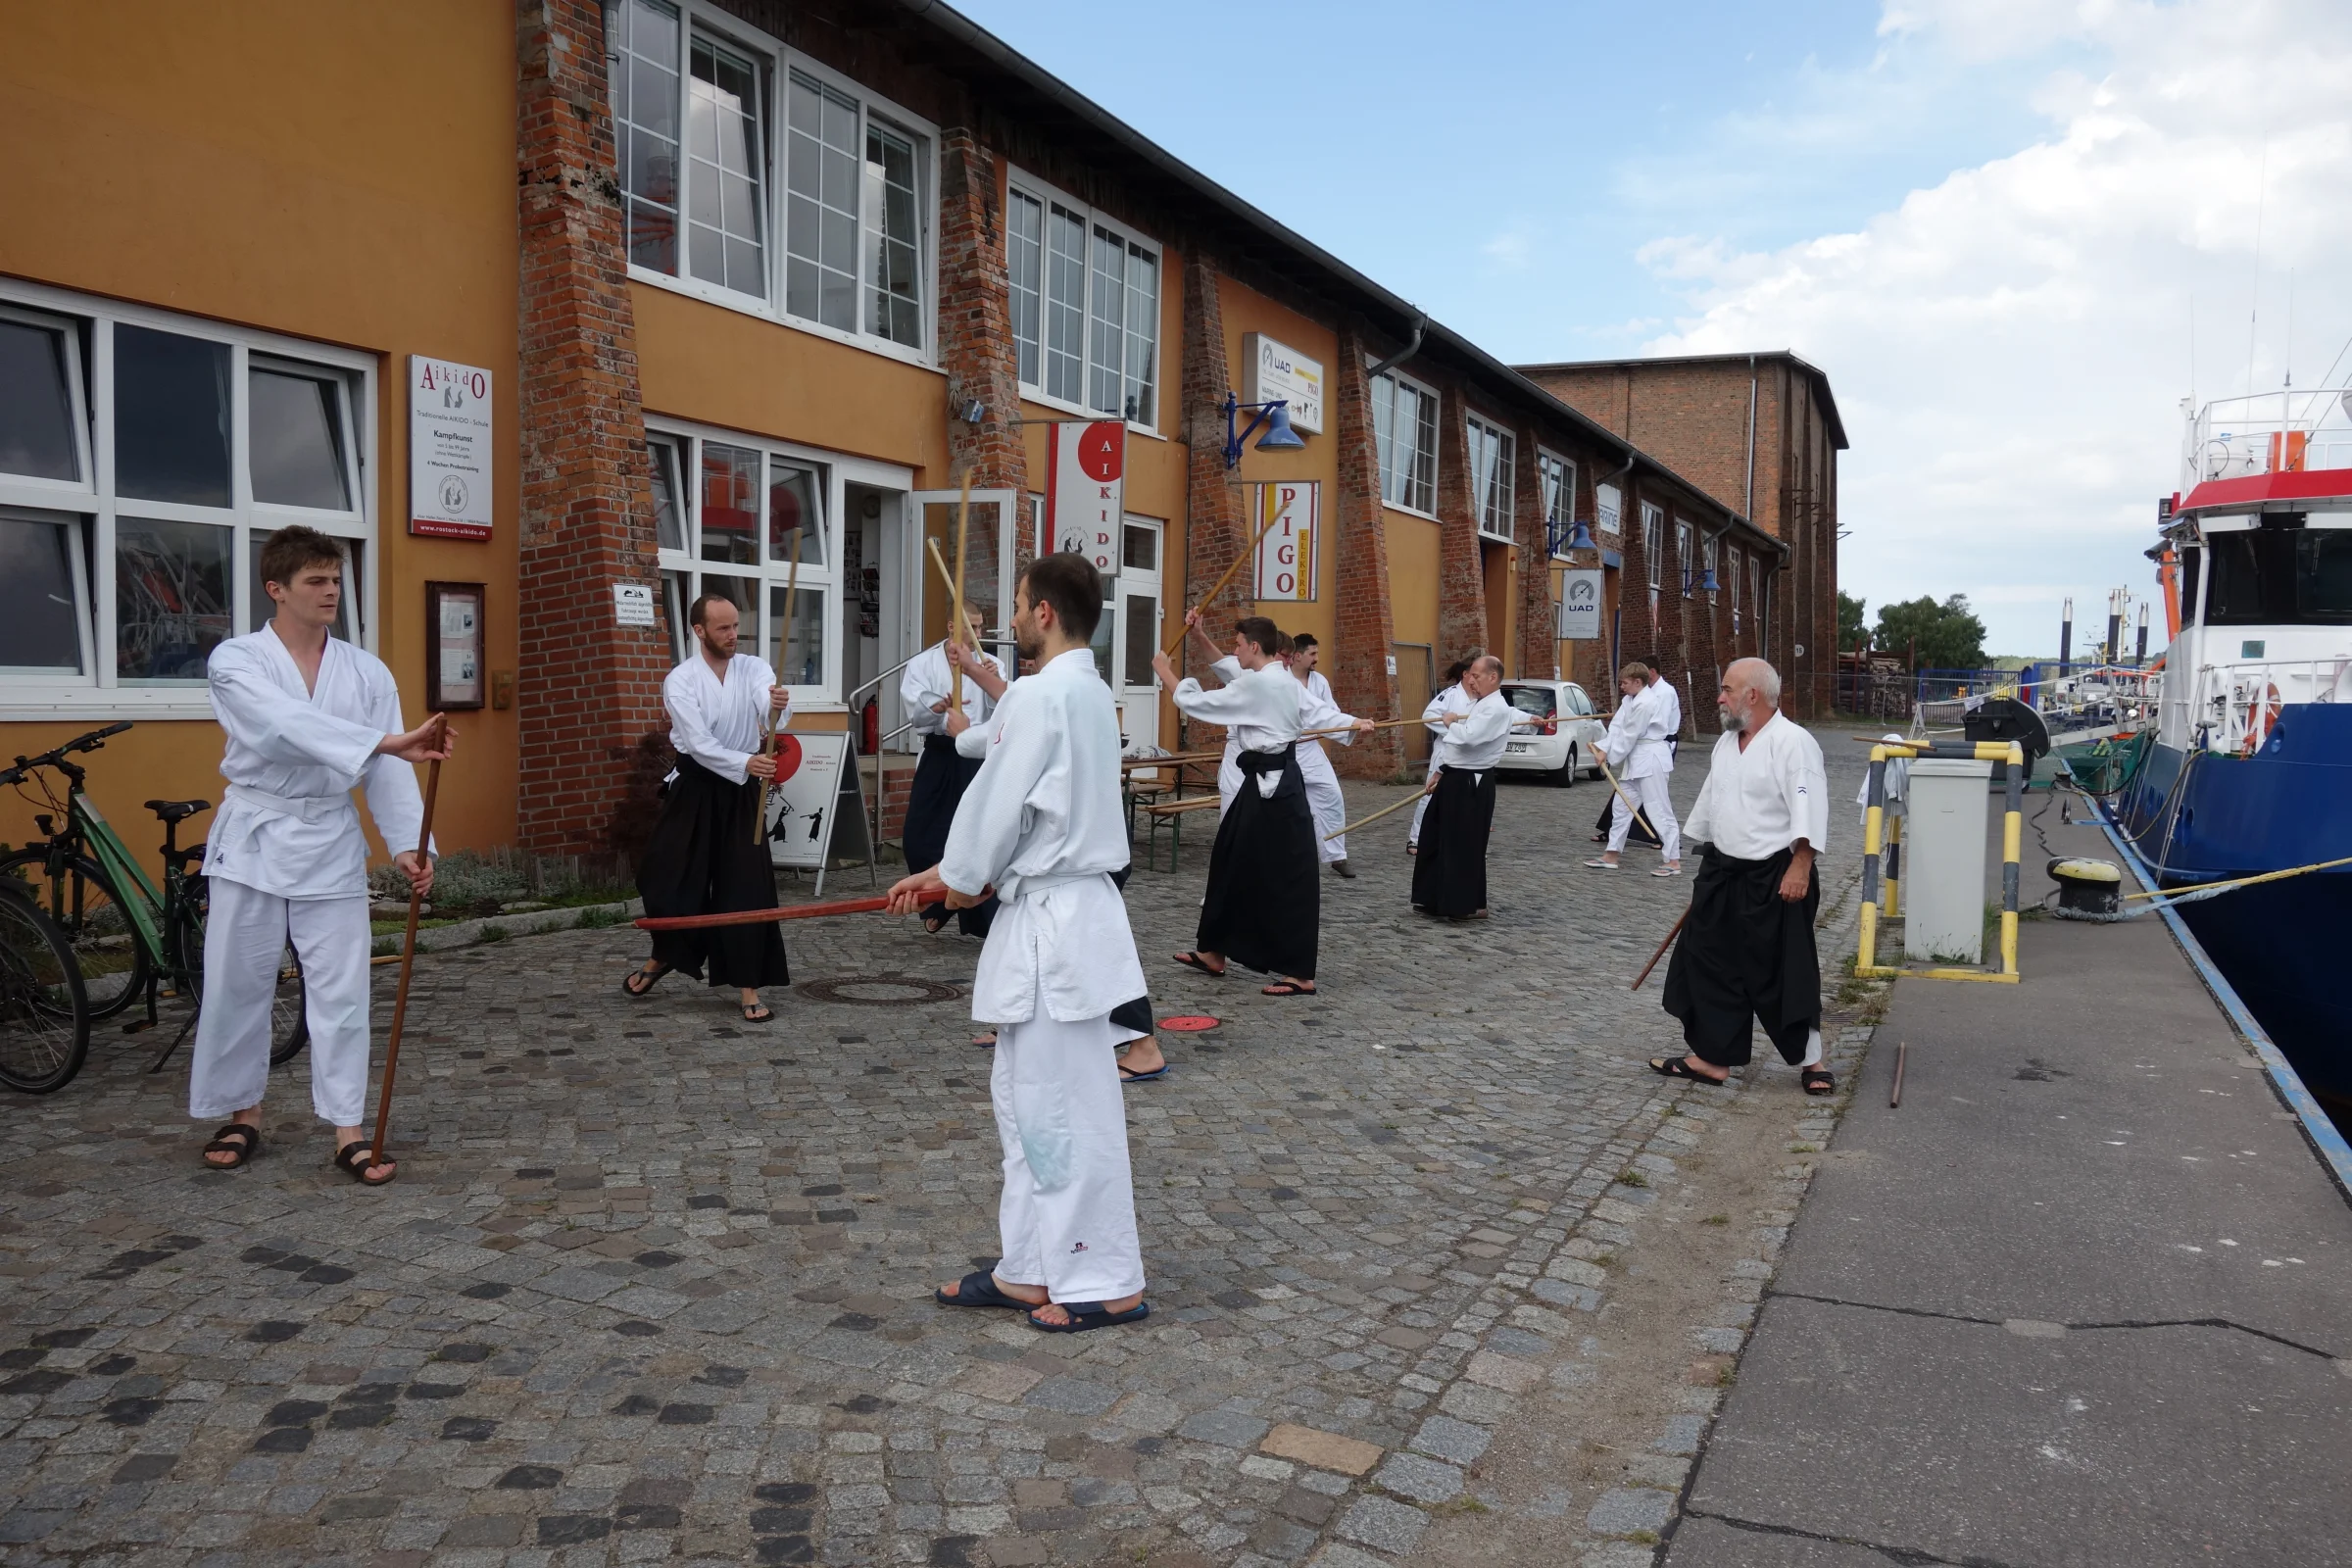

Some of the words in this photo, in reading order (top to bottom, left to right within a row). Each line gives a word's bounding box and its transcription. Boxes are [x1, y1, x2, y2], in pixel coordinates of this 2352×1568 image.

[1274, 358, 1291, 374] UAD
[1307, 382, 1318, 397] PIGO
[416, 410, 449, 421] Traditionelle
[472, 418, 489, 428] Schule
[433, 429, 472, 443] Kampfkunst
[450, 463, 479, 473] Probetraining
[1095, 440, 1112, 568] AIKIDO
[1598, 508, 1618, 528] ARINE
[420, 524, 486, 537] www.rostock-aikido.de
[1276, 488, 1296, 594] PIGO
[1298, 532, 1307, 597] ELEKTRO
